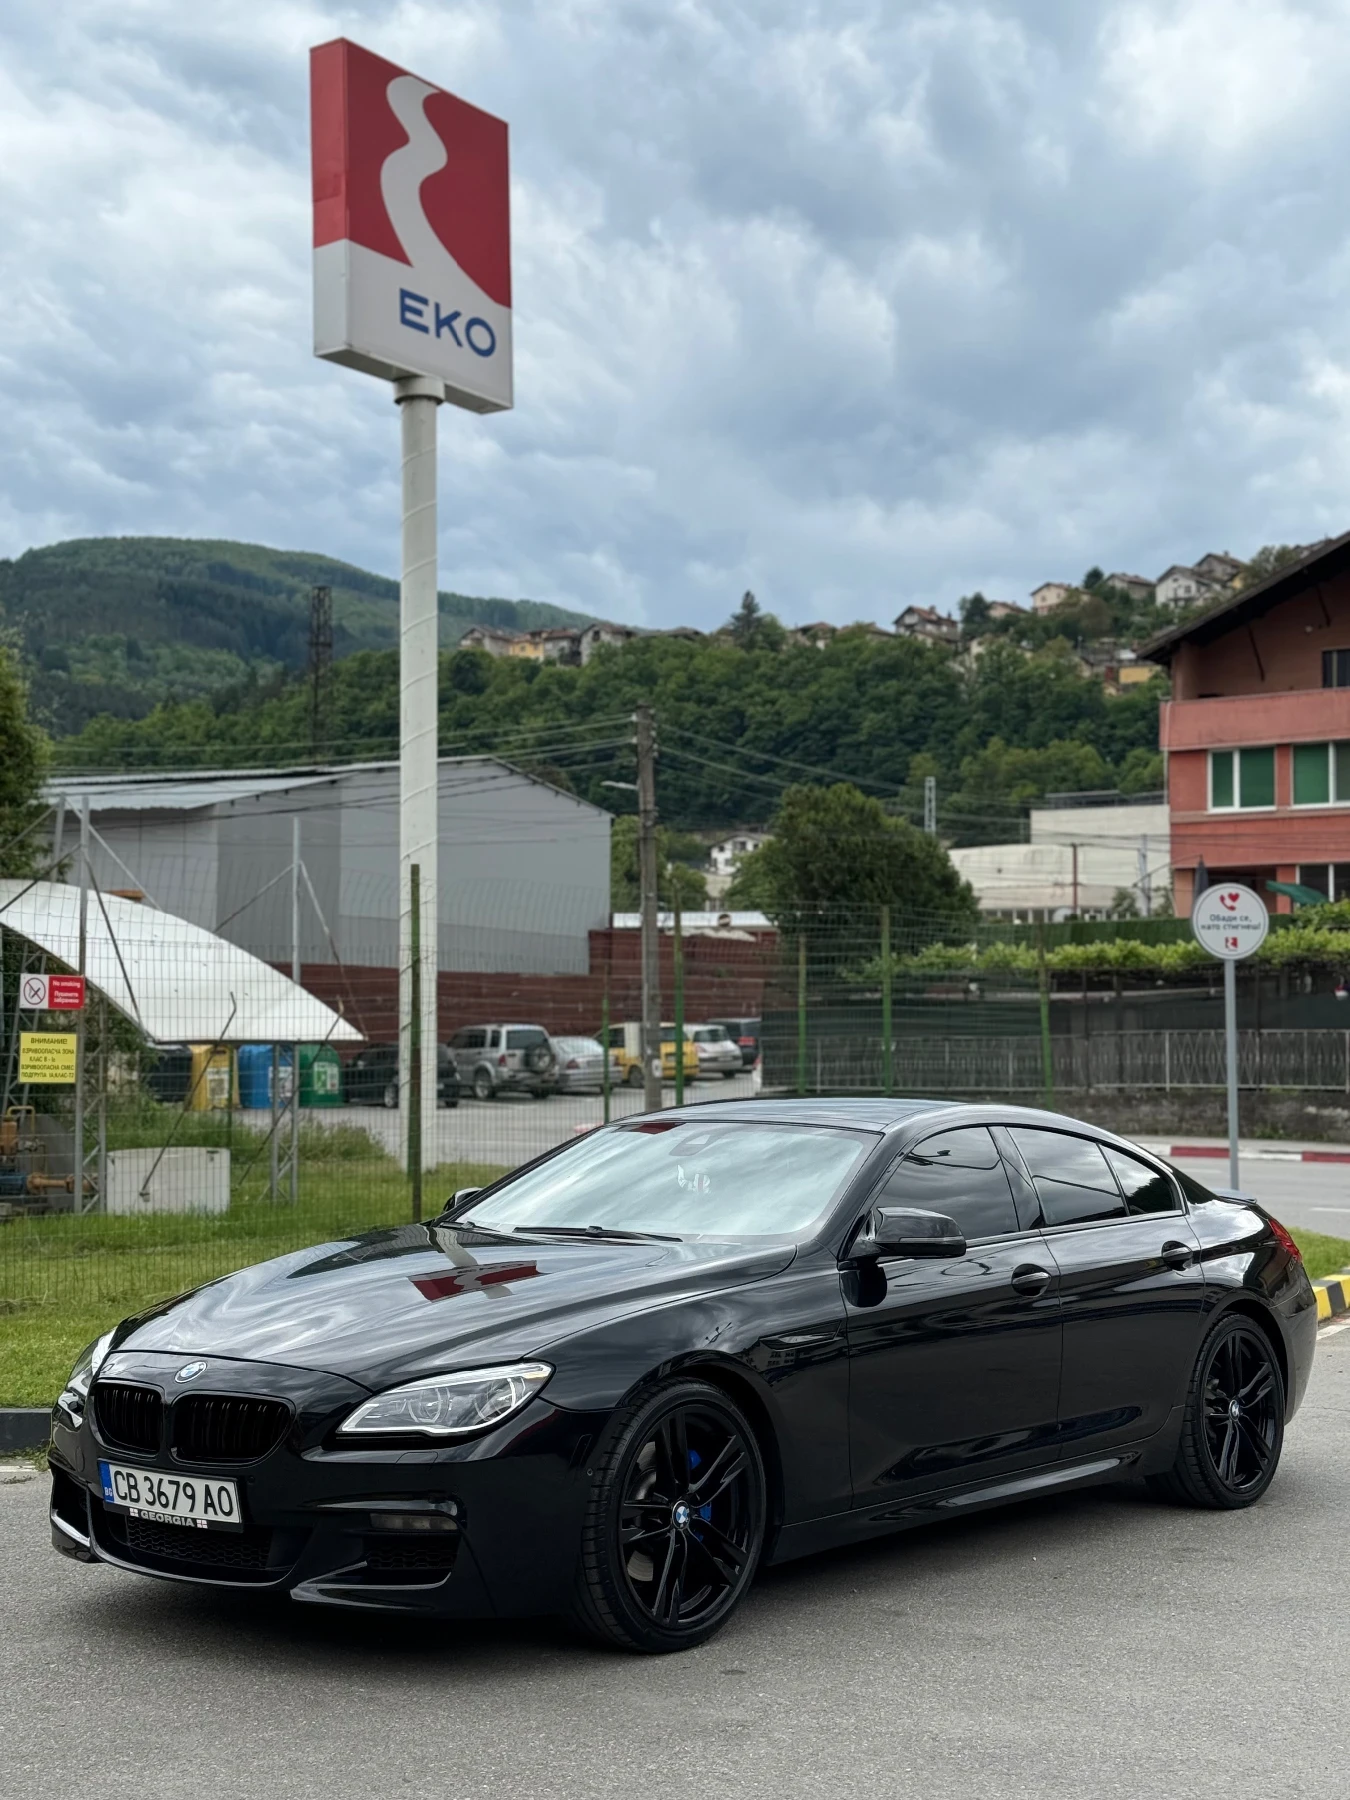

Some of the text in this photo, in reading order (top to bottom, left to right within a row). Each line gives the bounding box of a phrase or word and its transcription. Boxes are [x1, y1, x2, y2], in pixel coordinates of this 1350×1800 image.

[399, 287, 497, 358] EKO
[1209, 913, 1252, 923] Обади се,
[1222, 922, 1261, 930] стигнеш!
[104, 1470, 234, 1517] BG CB 3679 AO
[140, 1510, 195, 1527] GEORGIA
